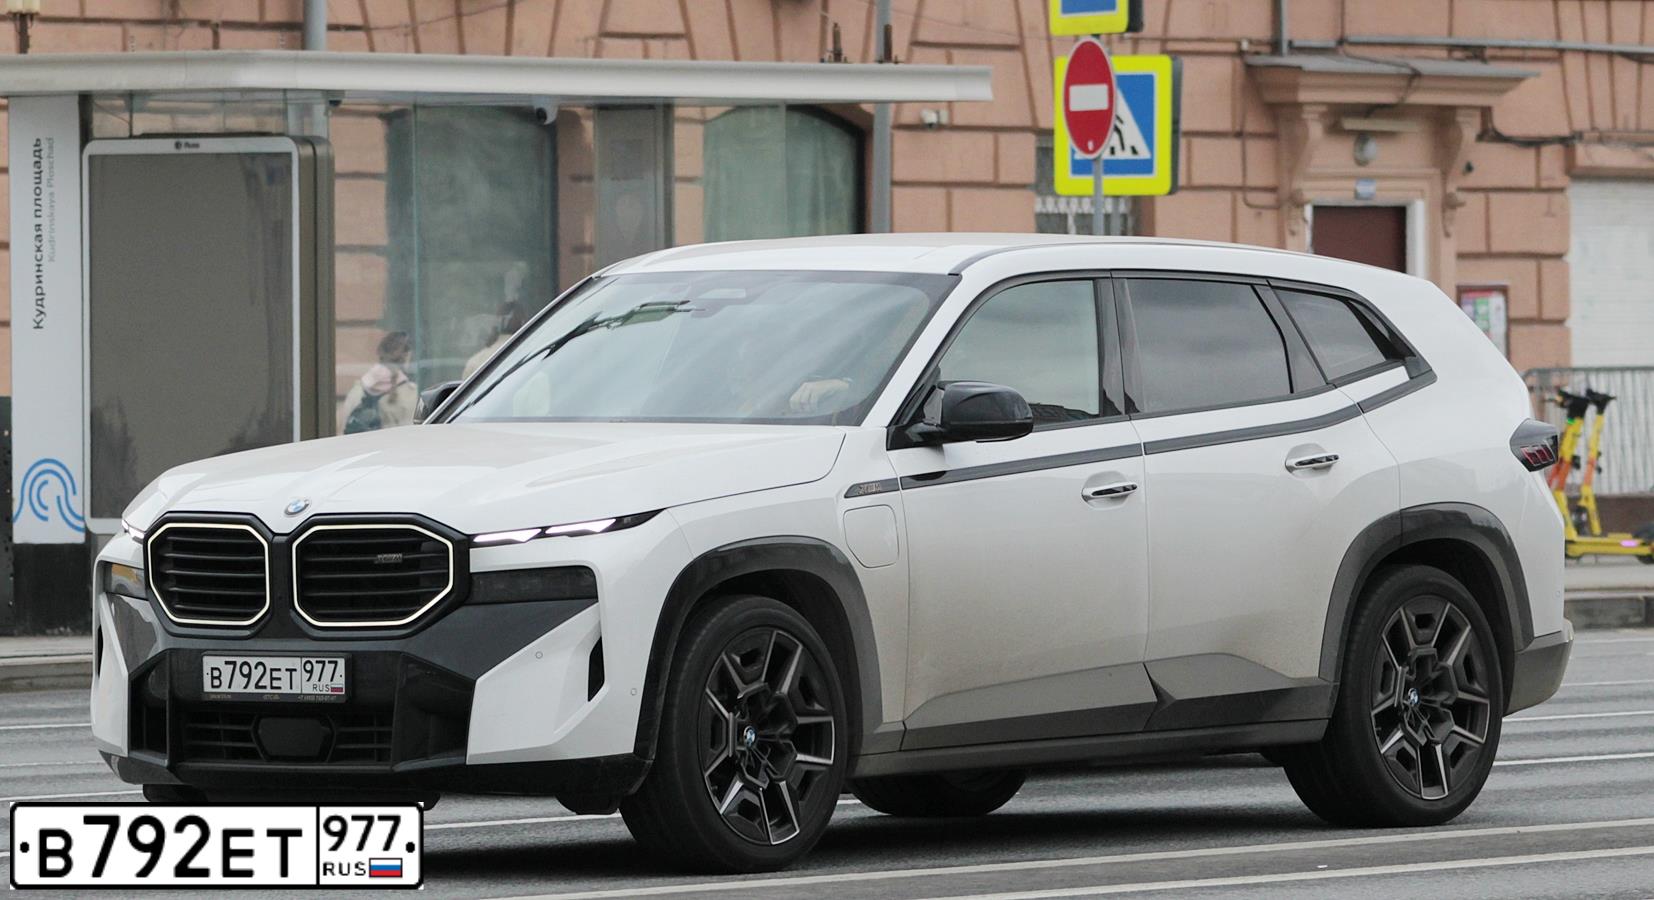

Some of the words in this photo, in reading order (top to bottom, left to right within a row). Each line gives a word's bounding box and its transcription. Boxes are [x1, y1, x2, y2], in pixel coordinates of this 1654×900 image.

[32, 137, 44, 219] площадь
[33, 223, 47, 330] Кудринская
[303, 659, 338, 682] 977
[312, 683, 330, 692] RUS
